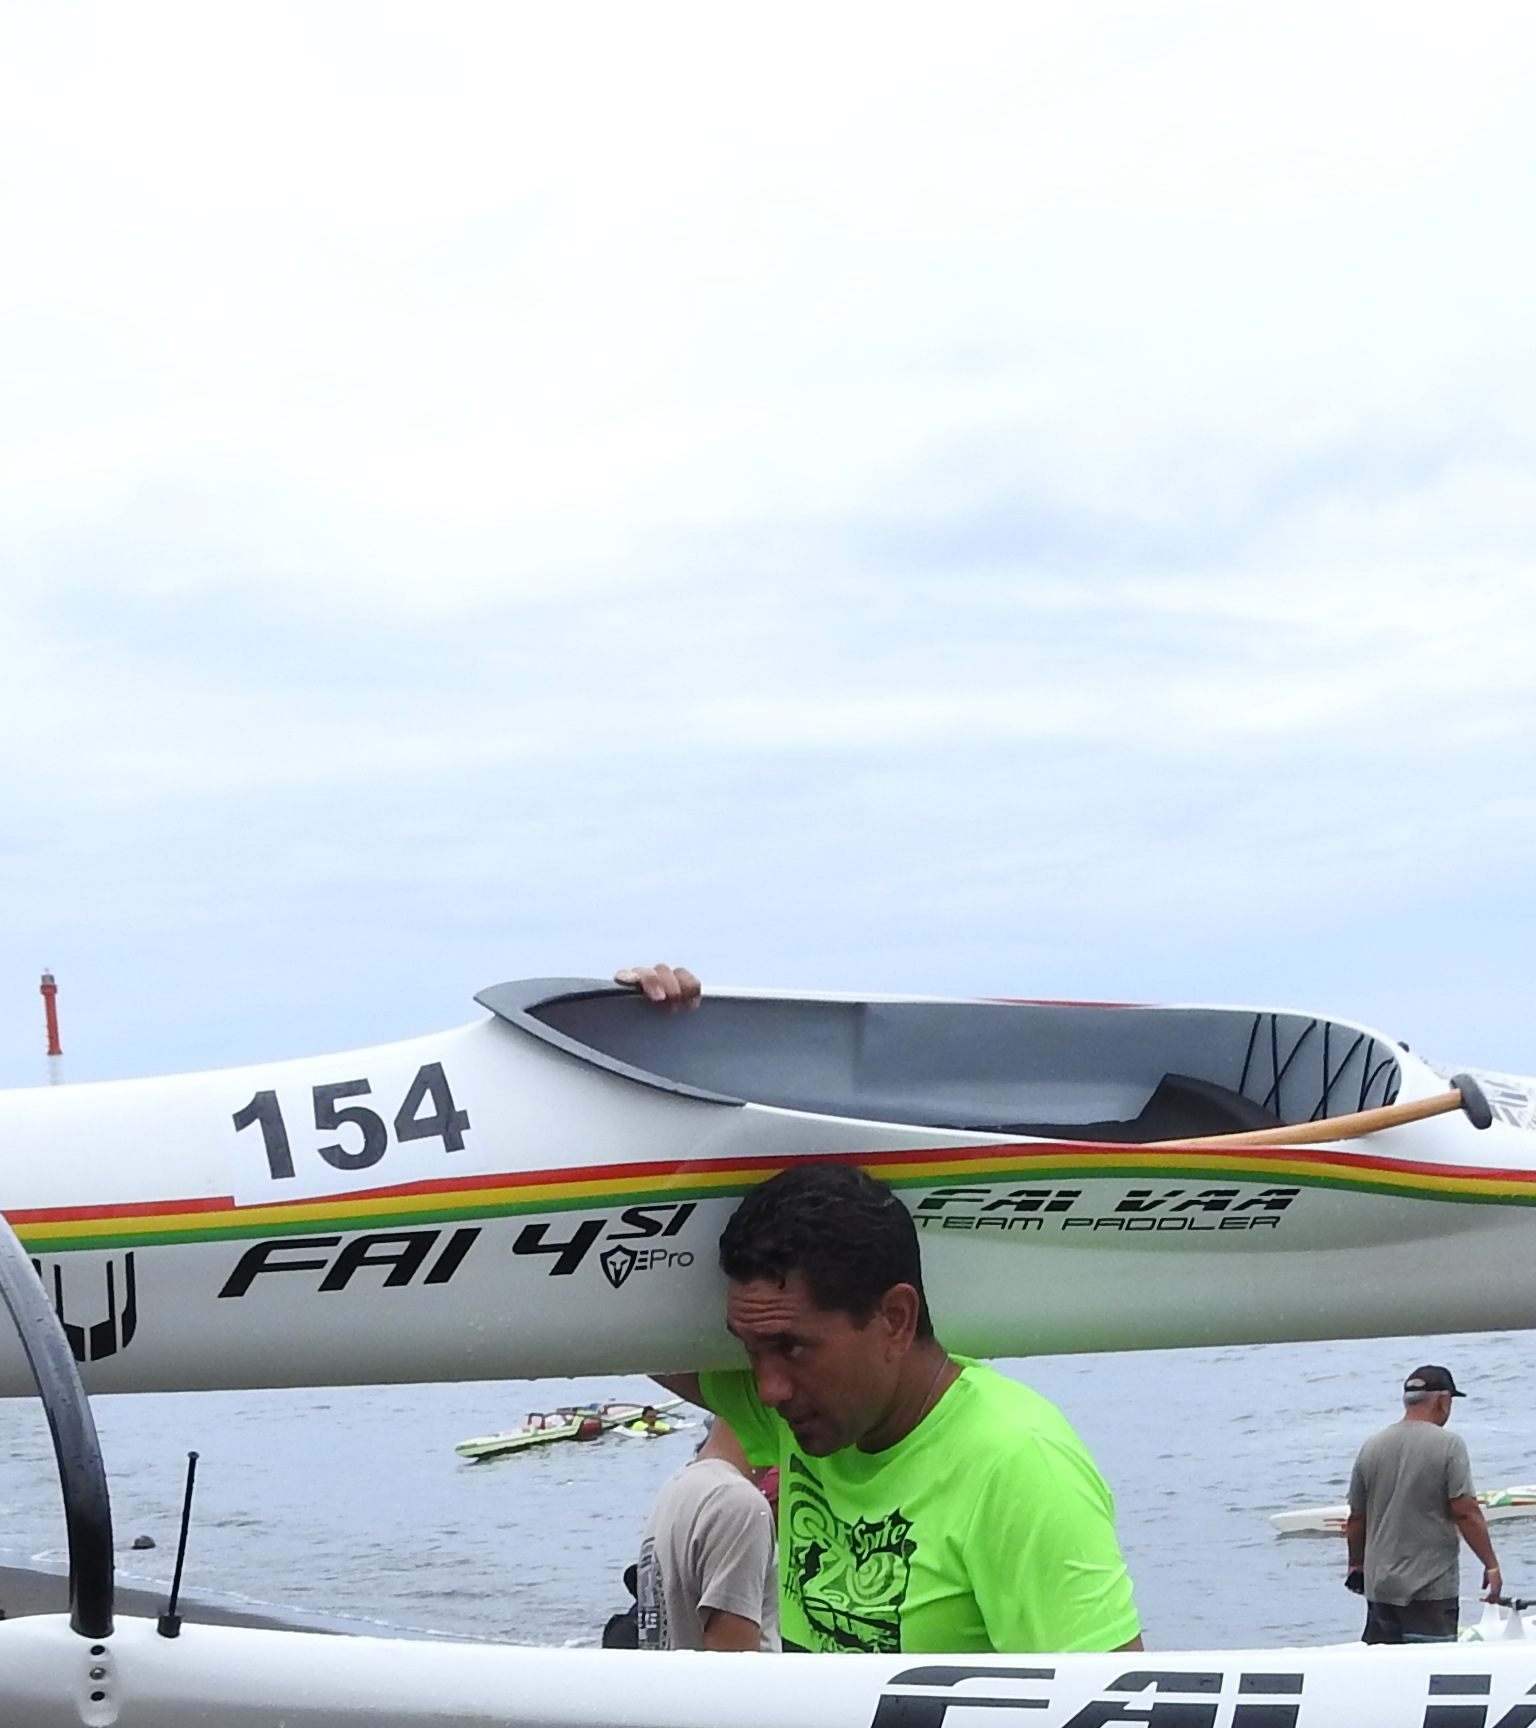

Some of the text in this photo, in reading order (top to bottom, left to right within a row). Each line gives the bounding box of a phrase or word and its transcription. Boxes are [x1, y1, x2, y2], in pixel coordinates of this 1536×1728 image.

[231, 1061, 471, 1181] 154
[912, 1214, 1281, 1231] TEAM PADDLER
[917, 1188, 1301, 1212] FAI VAA
[217, 1203, 697, 1298] FAI 4 SI
[854, 1515, 907, 1560] Sprite
